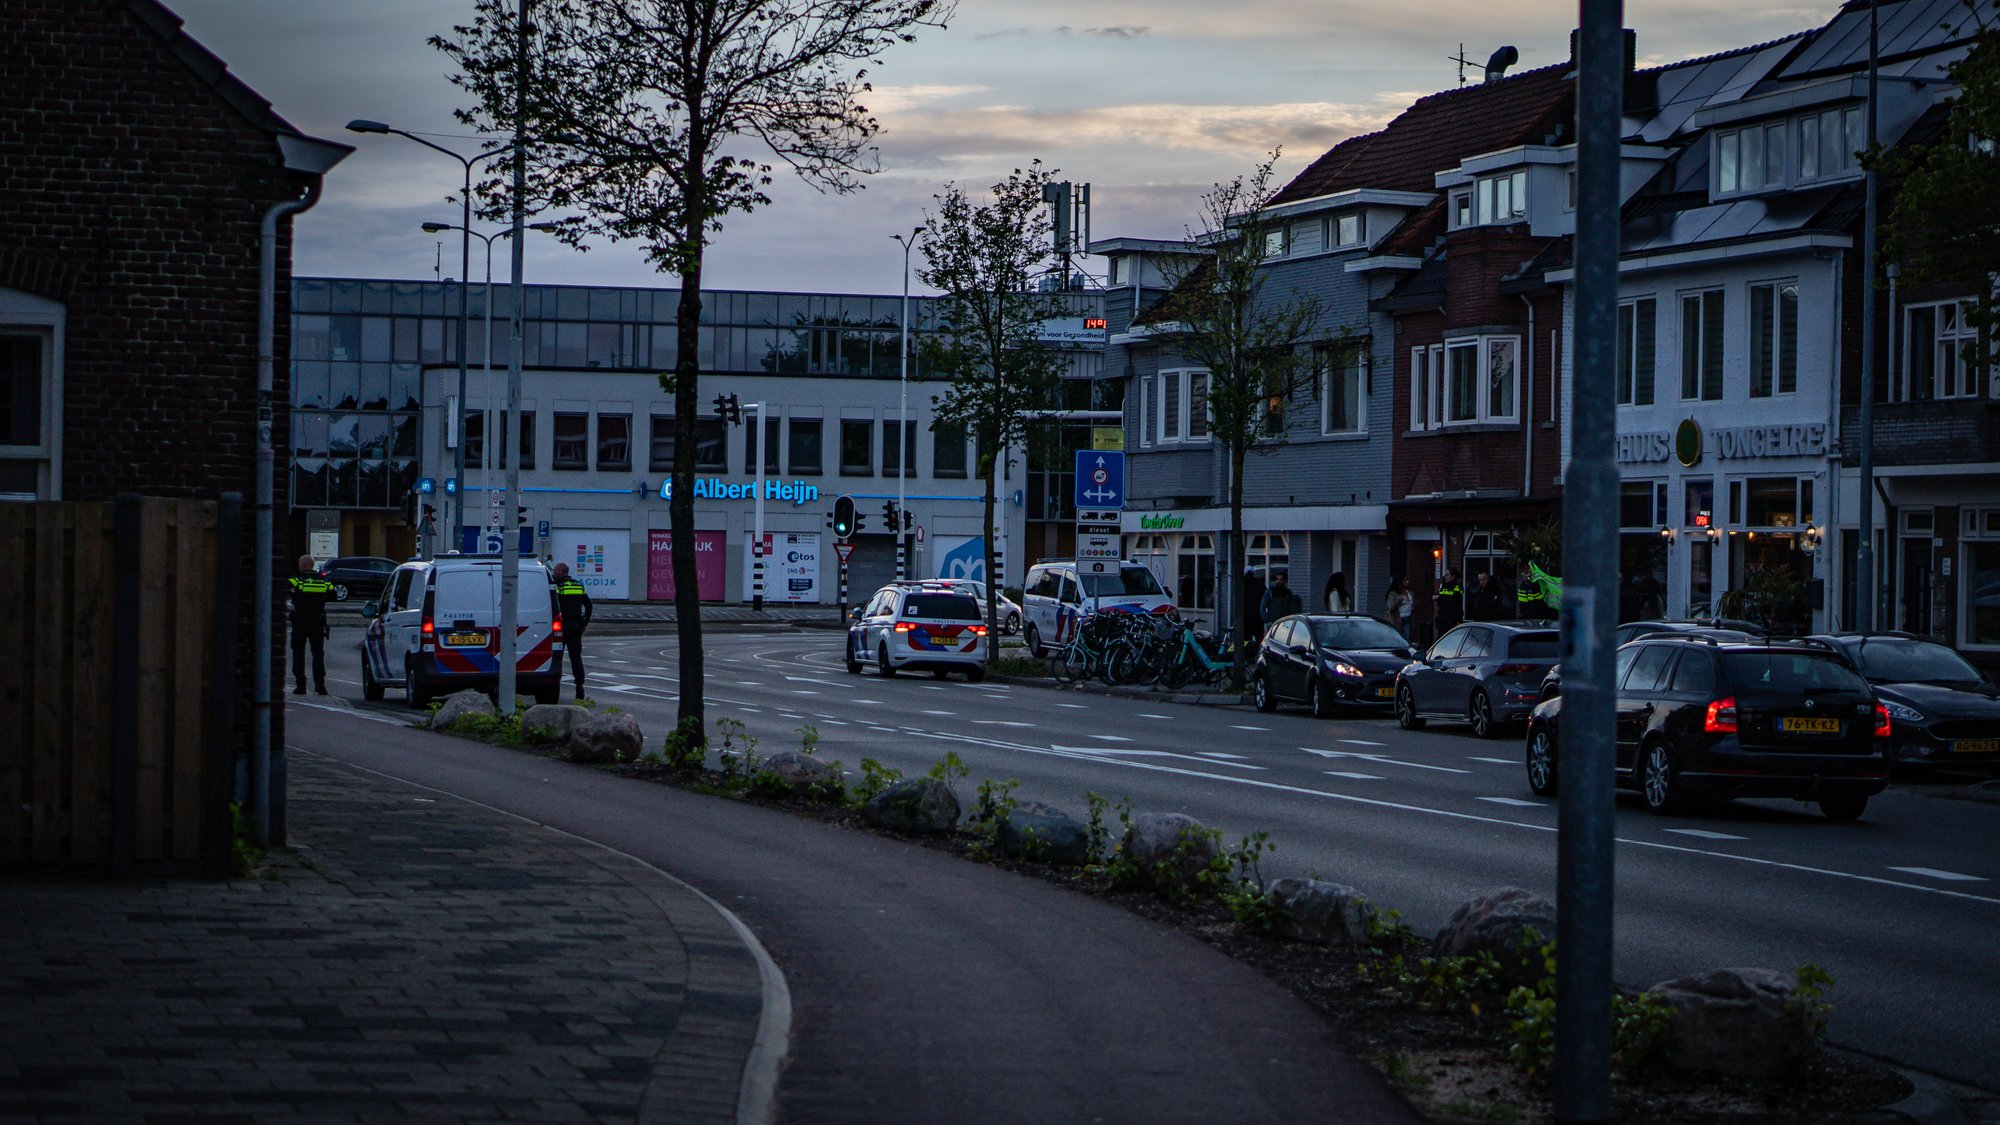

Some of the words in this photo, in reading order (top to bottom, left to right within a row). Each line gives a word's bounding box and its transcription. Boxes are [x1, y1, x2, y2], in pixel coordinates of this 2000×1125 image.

[1617, 431, 1670, 462] HUIS
[694, 478, 757, 499] Albert
[765, 480, 818, 505] Heijn
[1088, 526, 1110, 534] diesel
[1786, 719, 1836, 730] 76-TK-KZ
